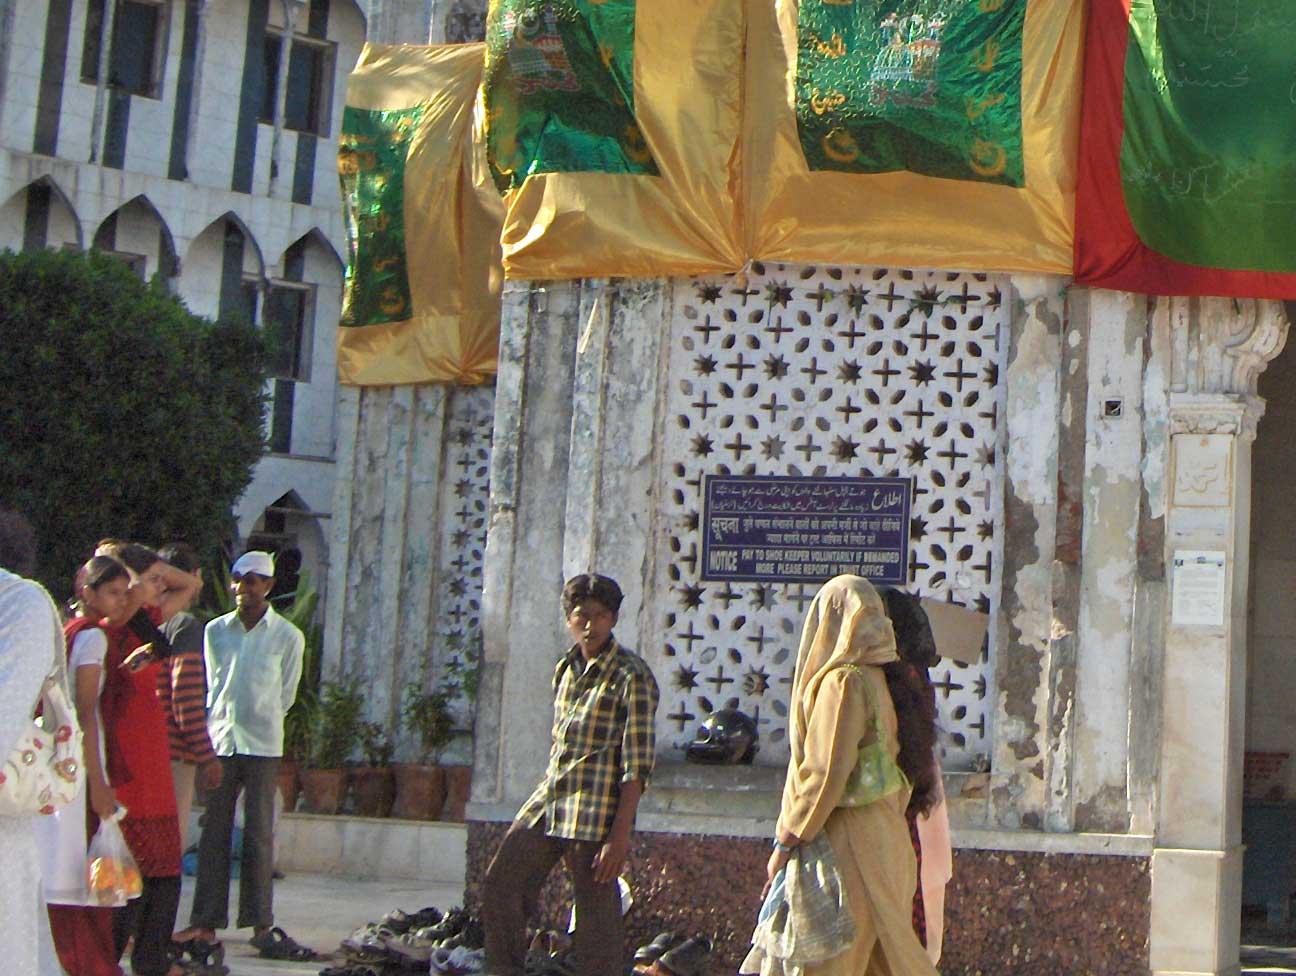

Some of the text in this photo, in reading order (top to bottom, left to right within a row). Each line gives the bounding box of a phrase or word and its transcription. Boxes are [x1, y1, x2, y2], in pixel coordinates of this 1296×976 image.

[872, 487, 903, 511] اطلاع
[712, 517, 739, 542] सूचना
[710, 550, 738, 571] NOTICE
[742, 549, 754, 560] PAY
[755, 549, 764, 560] TO
[765, 549, 783, 561] SHOE
[784, 549, 810, 561] KEEPER
[811, 550, 854, 562] VOLUNTARILY
[856, 551, 863, 562] IF
[755, 562, 774, 574] MORE
[777, 562, 802, 575] PLEASE
[803, 563, 829, 575] REPORT
[831, 564, 838, 575] IN
[861, 564, 884, 576] OFFICE
